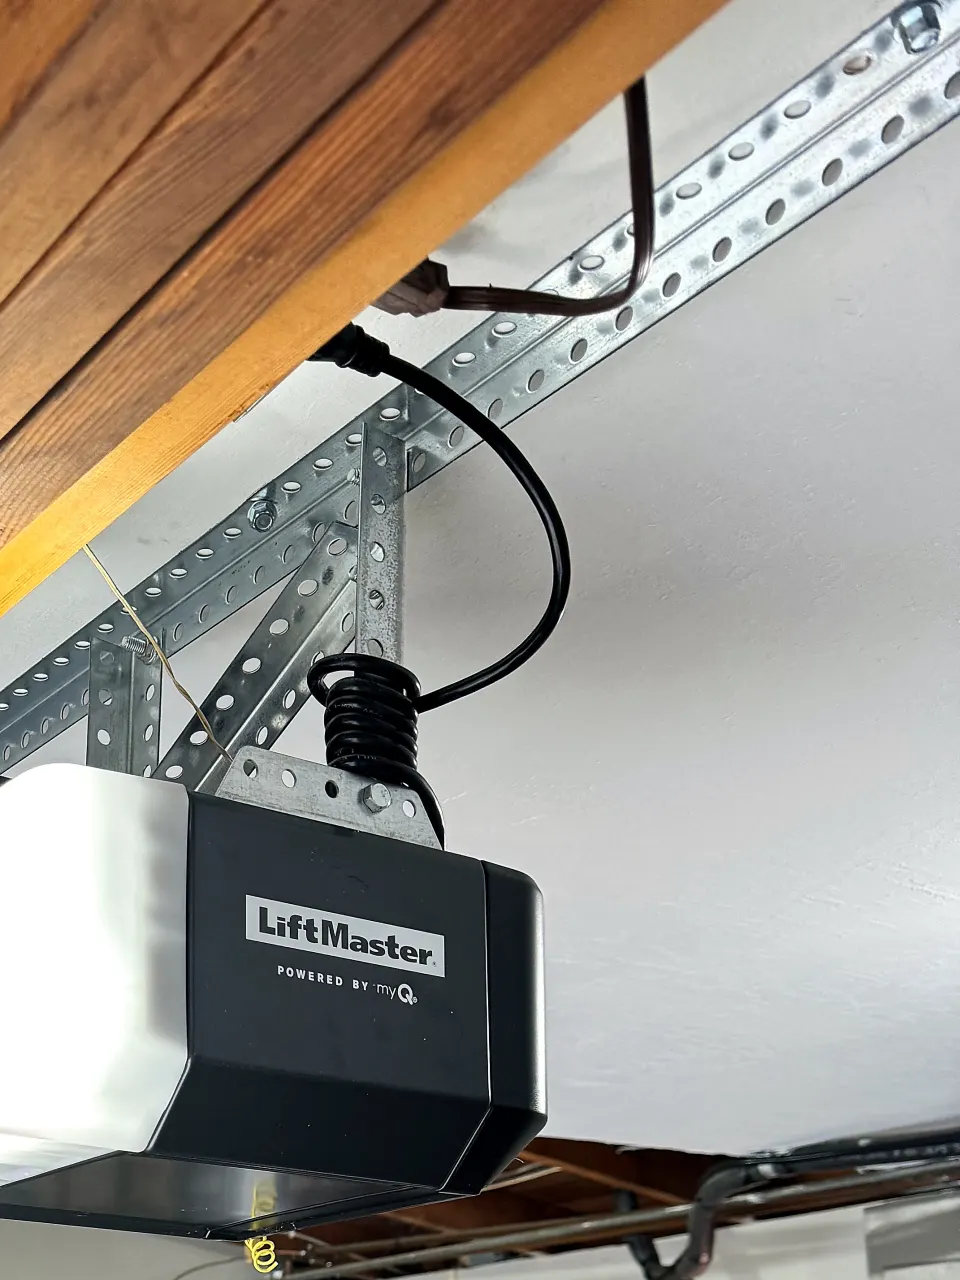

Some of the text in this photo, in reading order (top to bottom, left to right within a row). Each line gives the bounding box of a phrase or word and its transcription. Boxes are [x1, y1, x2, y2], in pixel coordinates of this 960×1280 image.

[259, 905, 433, 966] LiftMaster
[277, 964, 343, 987] POWERED
[352, 979, 369, 991] BY
